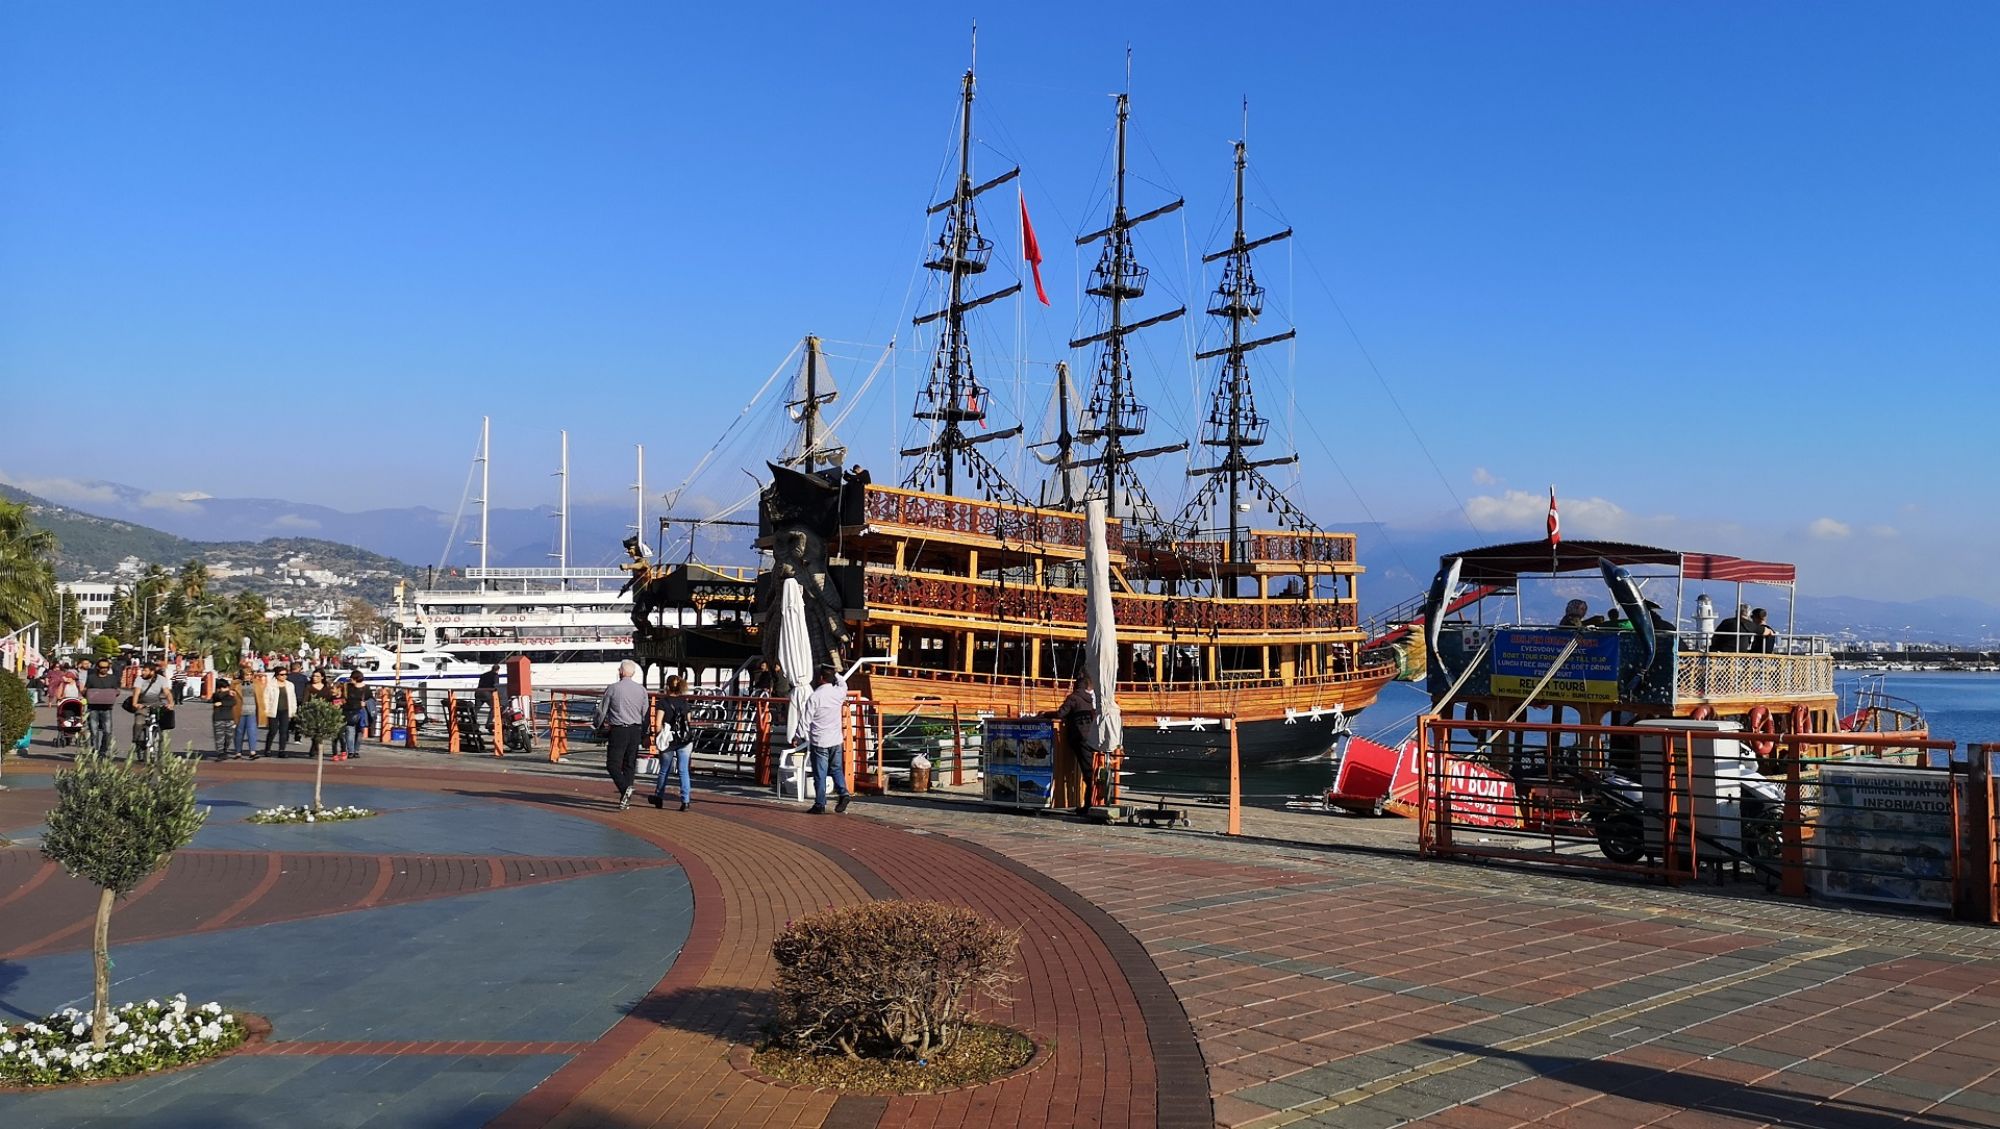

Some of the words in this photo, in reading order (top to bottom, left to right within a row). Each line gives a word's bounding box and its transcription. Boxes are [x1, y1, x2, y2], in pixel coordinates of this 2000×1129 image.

[1521, 645, 1555, 653] EVERYDAY
[1590, 664, 1612, 672] DRINK
[1519, 678, 1549, 690] RELX
[1554, 680, 1586, 692] TOURS
[1468, 766, 1508, 799] BOAT
[1935, 782, 1963, 799] TOR
[1863, 797, 1952, 812] INFORMATION
